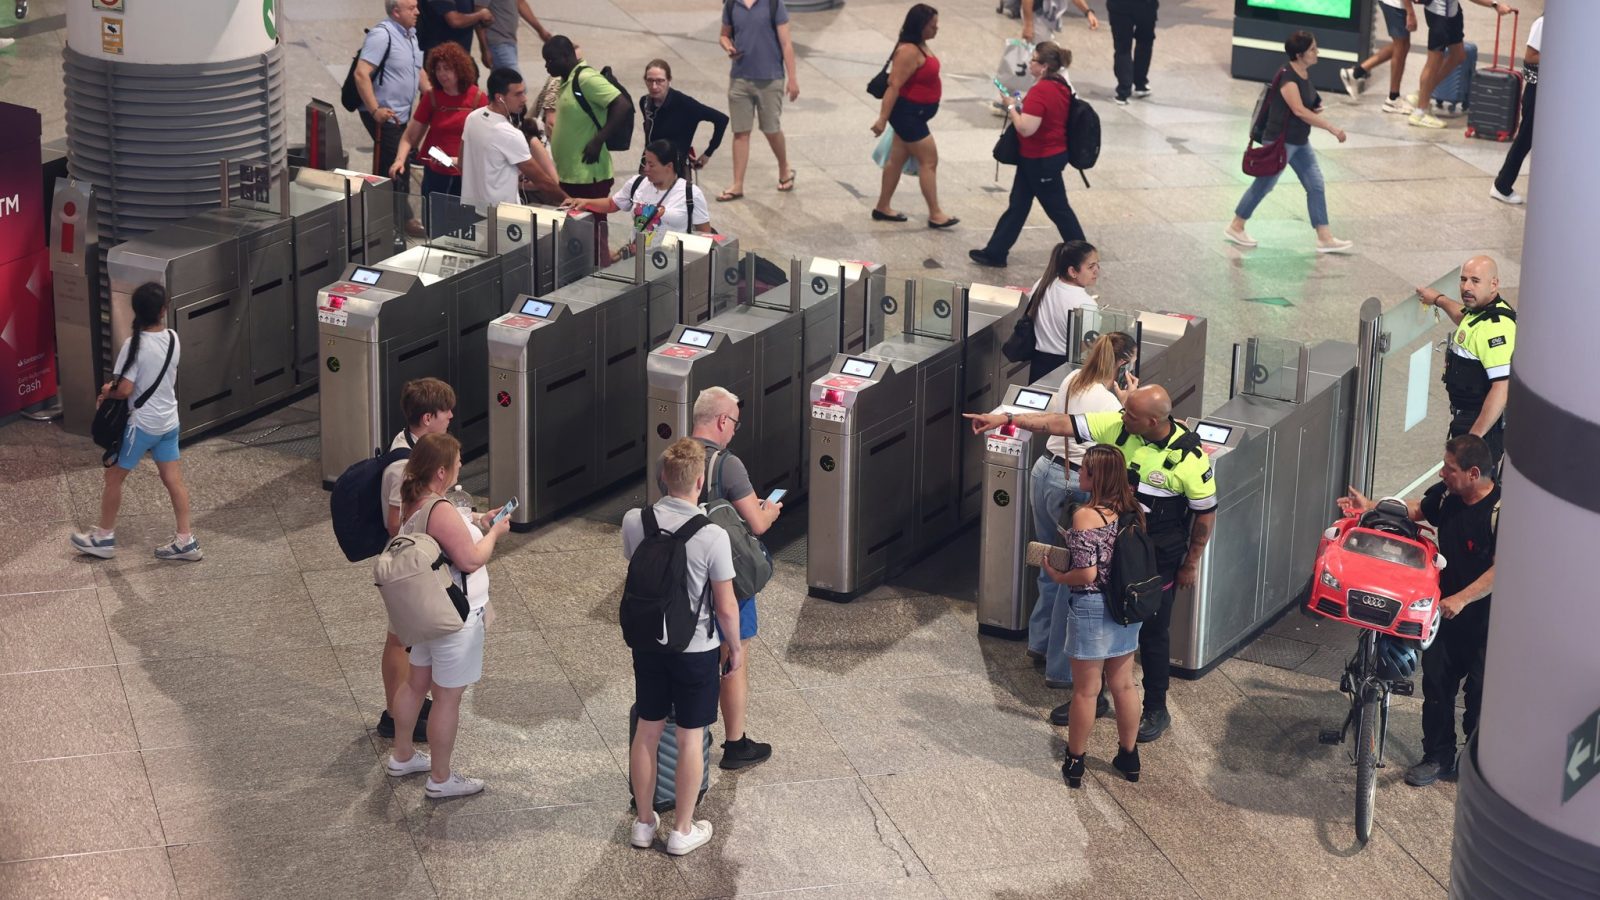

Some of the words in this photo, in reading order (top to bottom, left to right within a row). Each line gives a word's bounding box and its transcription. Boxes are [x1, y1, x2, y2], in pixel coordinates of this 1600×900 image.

[499, 372, 507, 380] 24
[18, 378, 42, 396] Cash
[659, 404, 668, 412] 25
